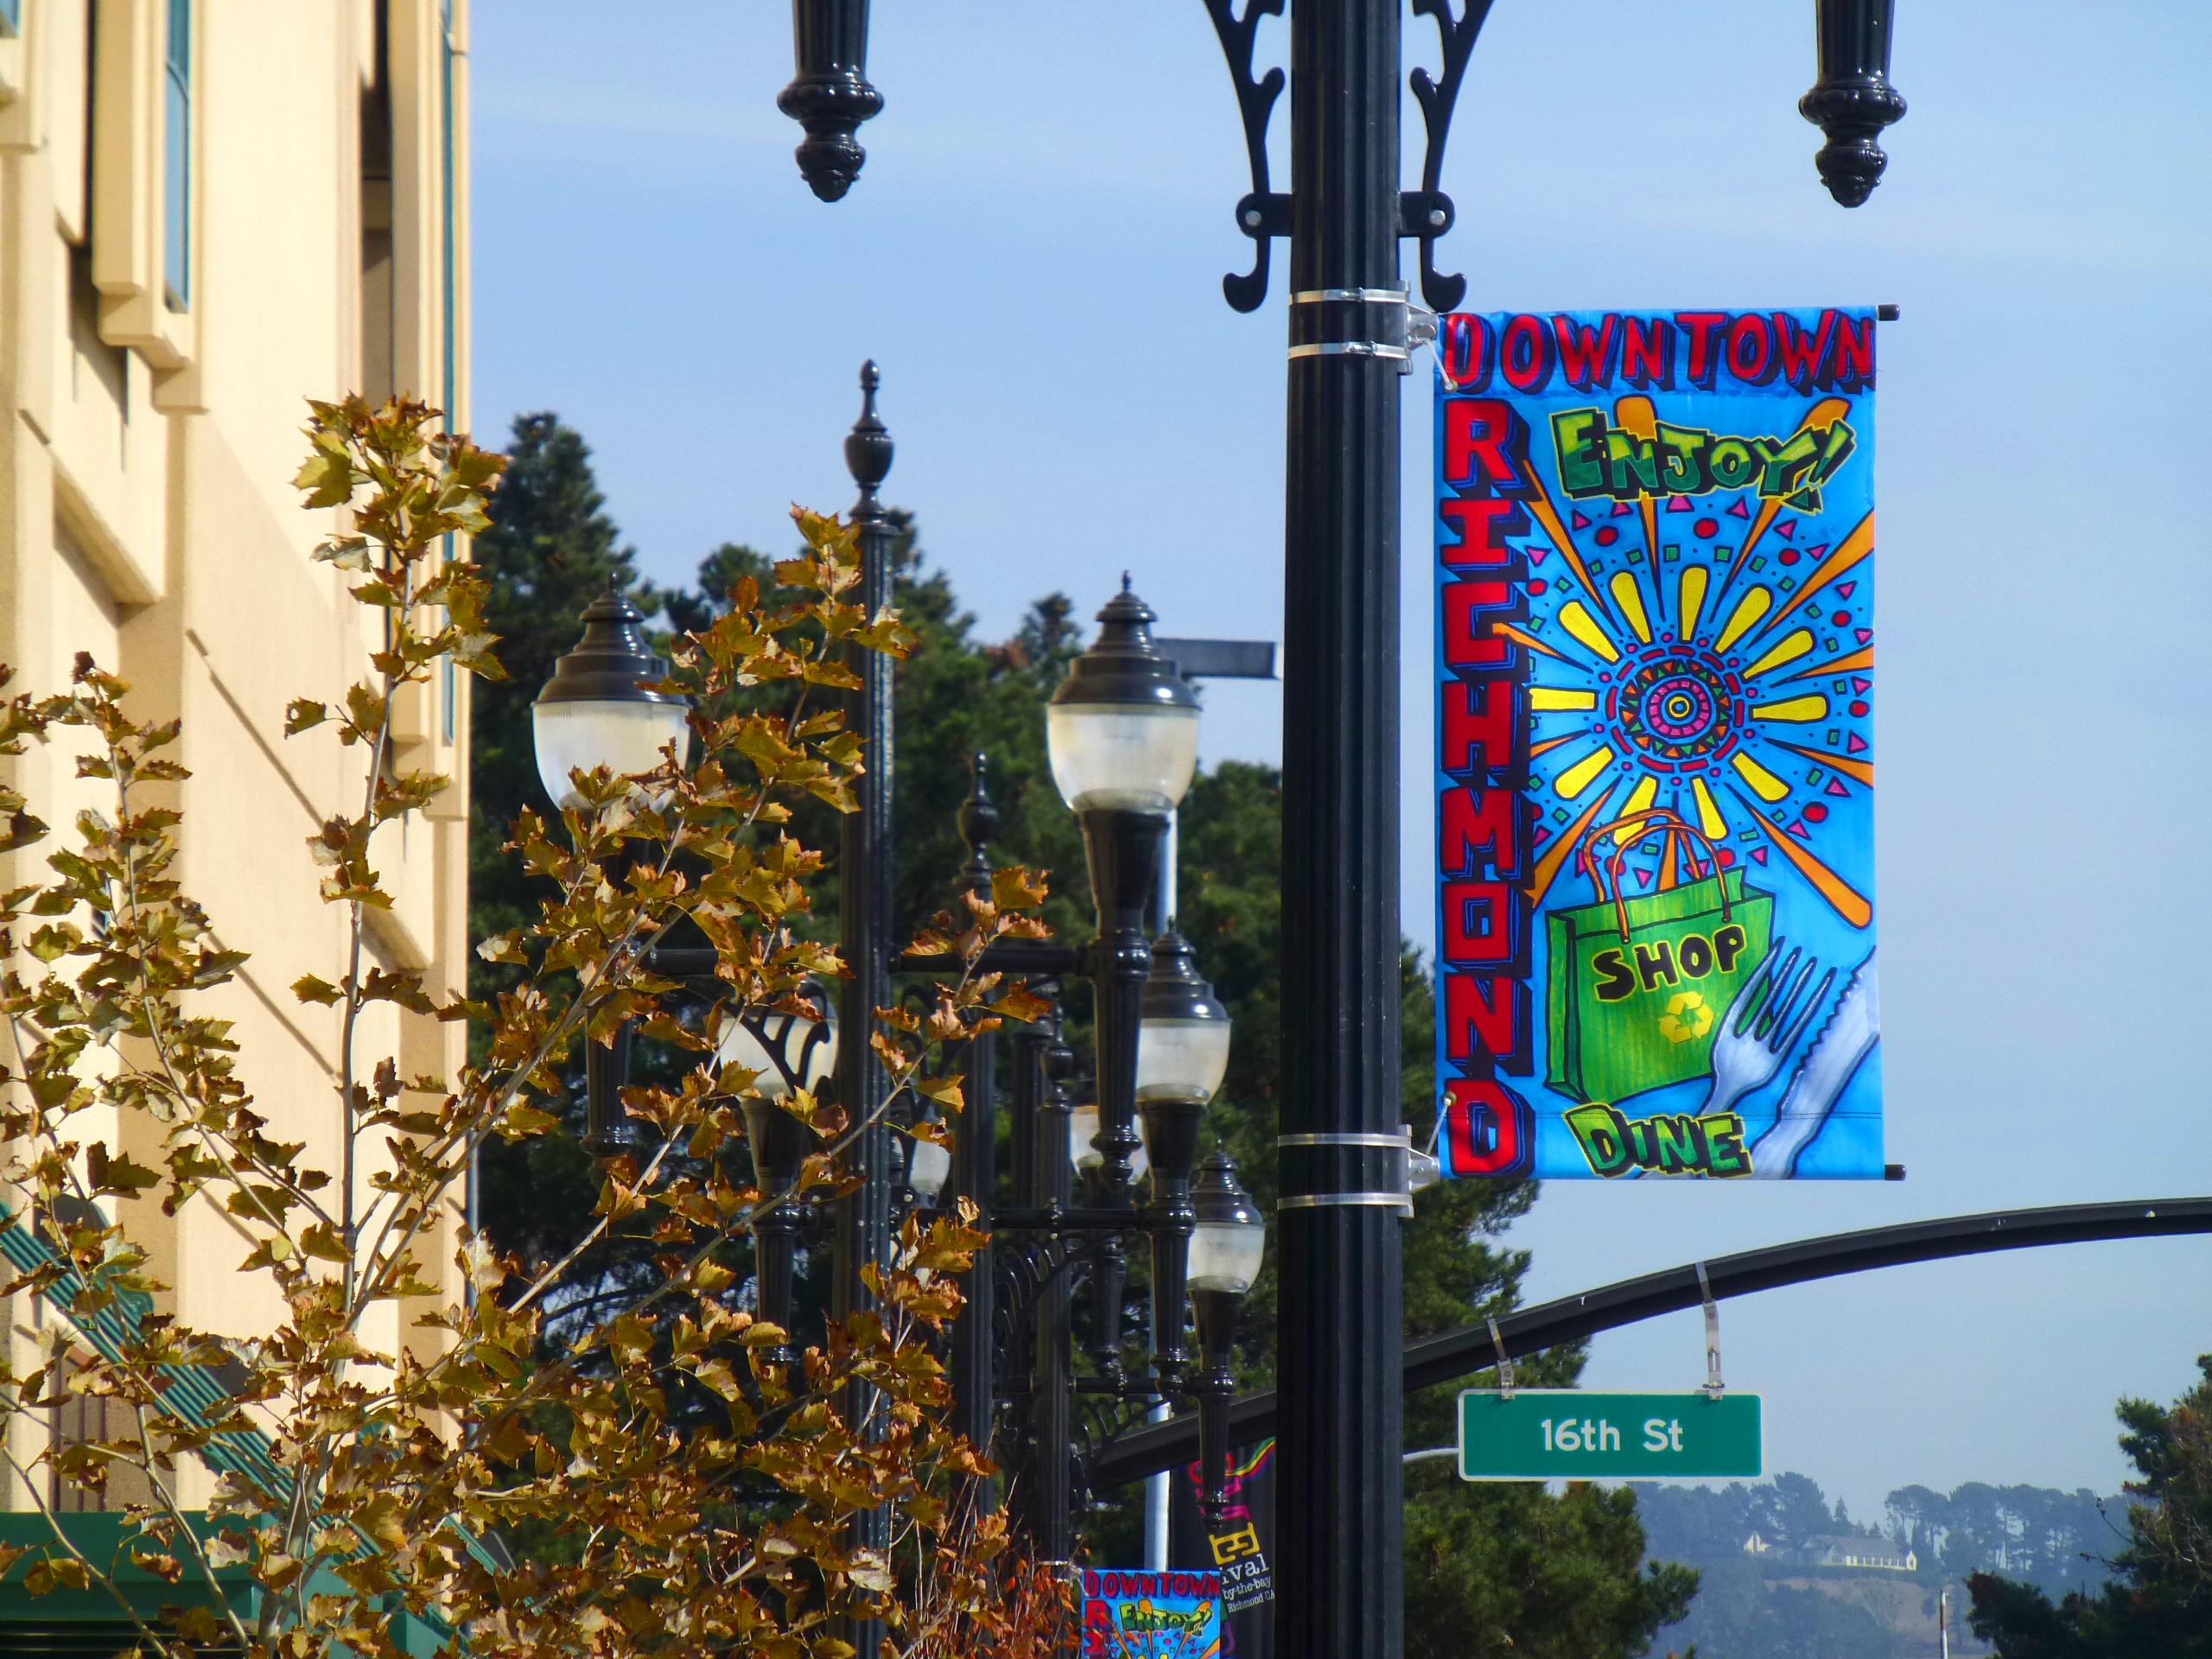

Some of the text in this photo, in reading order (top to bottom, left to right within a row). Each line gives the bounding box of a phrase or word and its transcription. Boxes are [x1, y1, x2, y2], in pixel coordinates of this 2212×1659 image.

[1440, 308, 1877, 395] DOWNTOWN
[1440, 397, 1535, 1179] RICHMOND
[1590, 925, 1747, 1004] SHOP
[1541, 1419, 1684, 1452] 16th St
[1084, 1569, 1221, 1599] DOWNTOWN
[1221, 1553, 1270, 1586] ival
